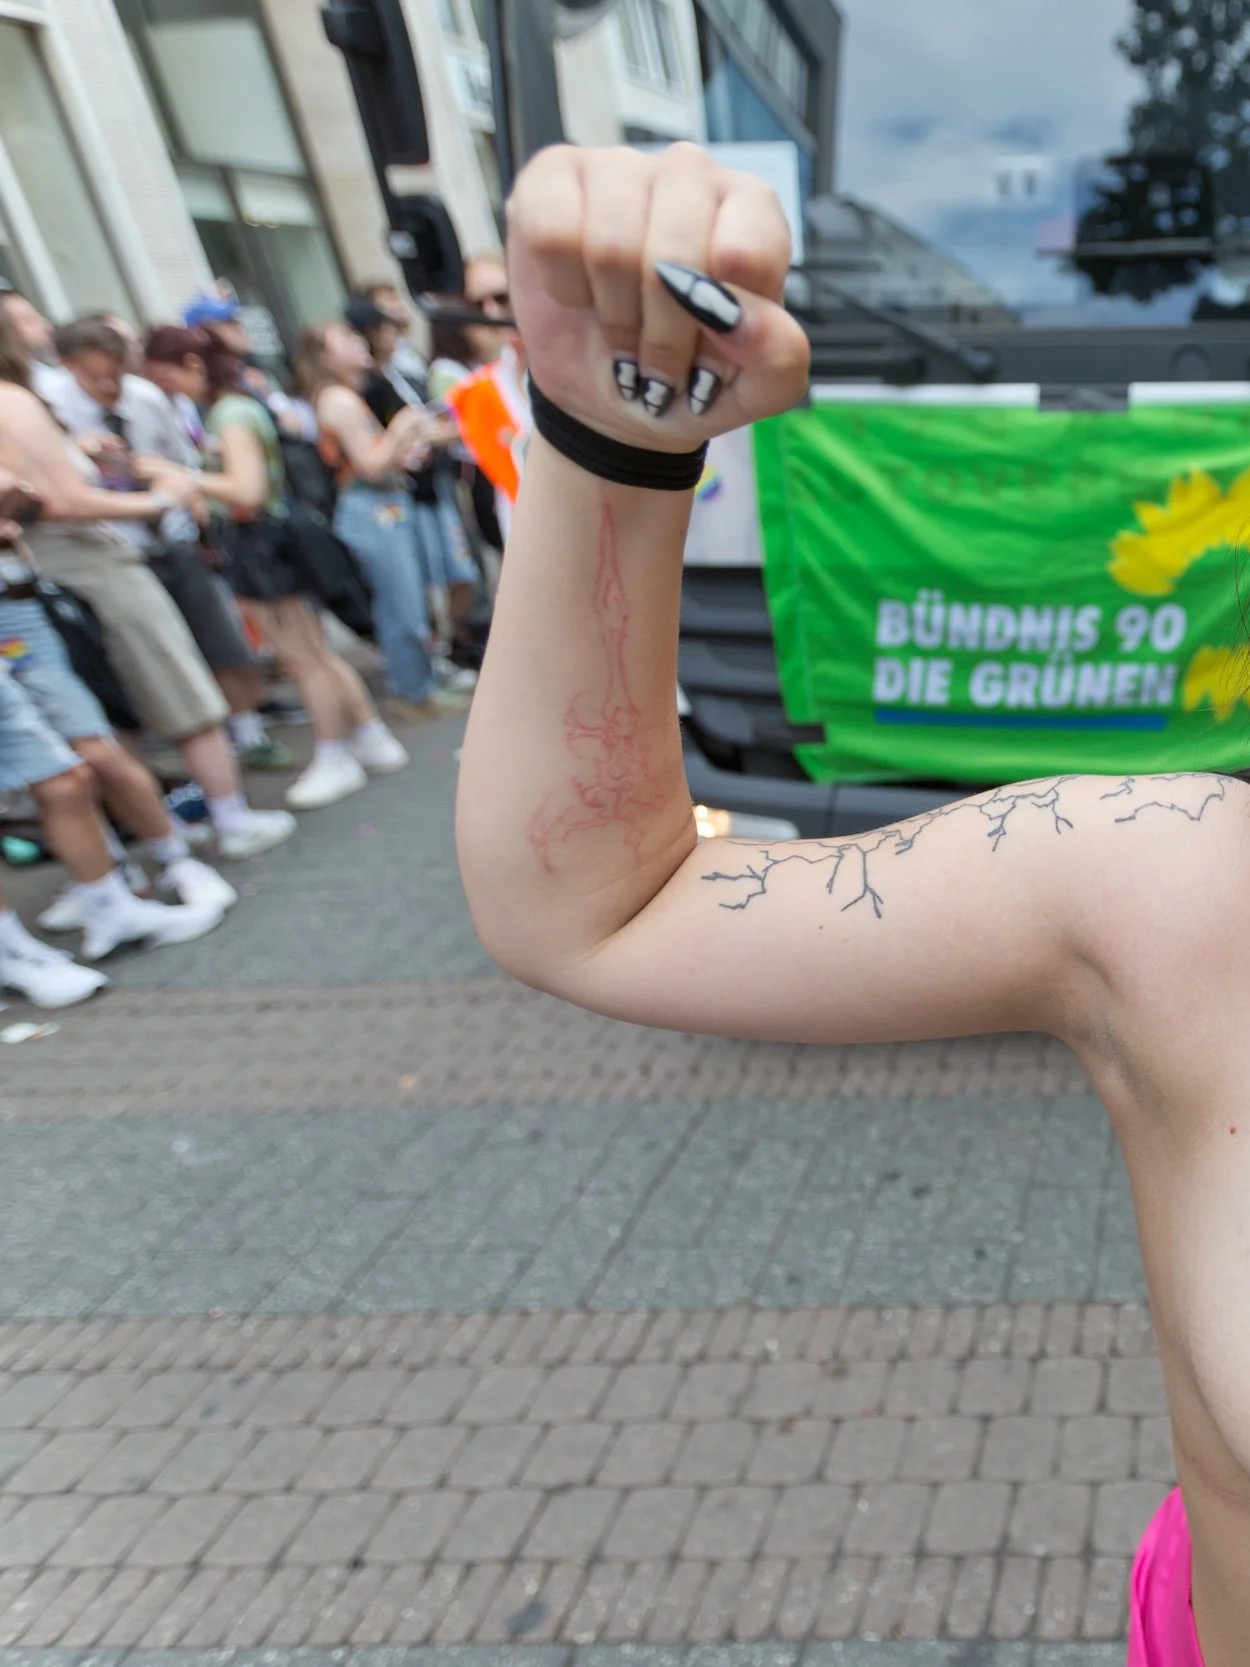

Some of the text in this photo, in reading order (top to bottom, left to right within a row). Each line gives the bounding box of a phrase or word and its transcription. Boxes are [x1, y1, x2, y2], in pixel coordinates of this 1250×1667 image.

[875, 588, 1188, 653] BÜNDNIS 90
[872, 651, 1180, 709] DIE GRÜNEN
